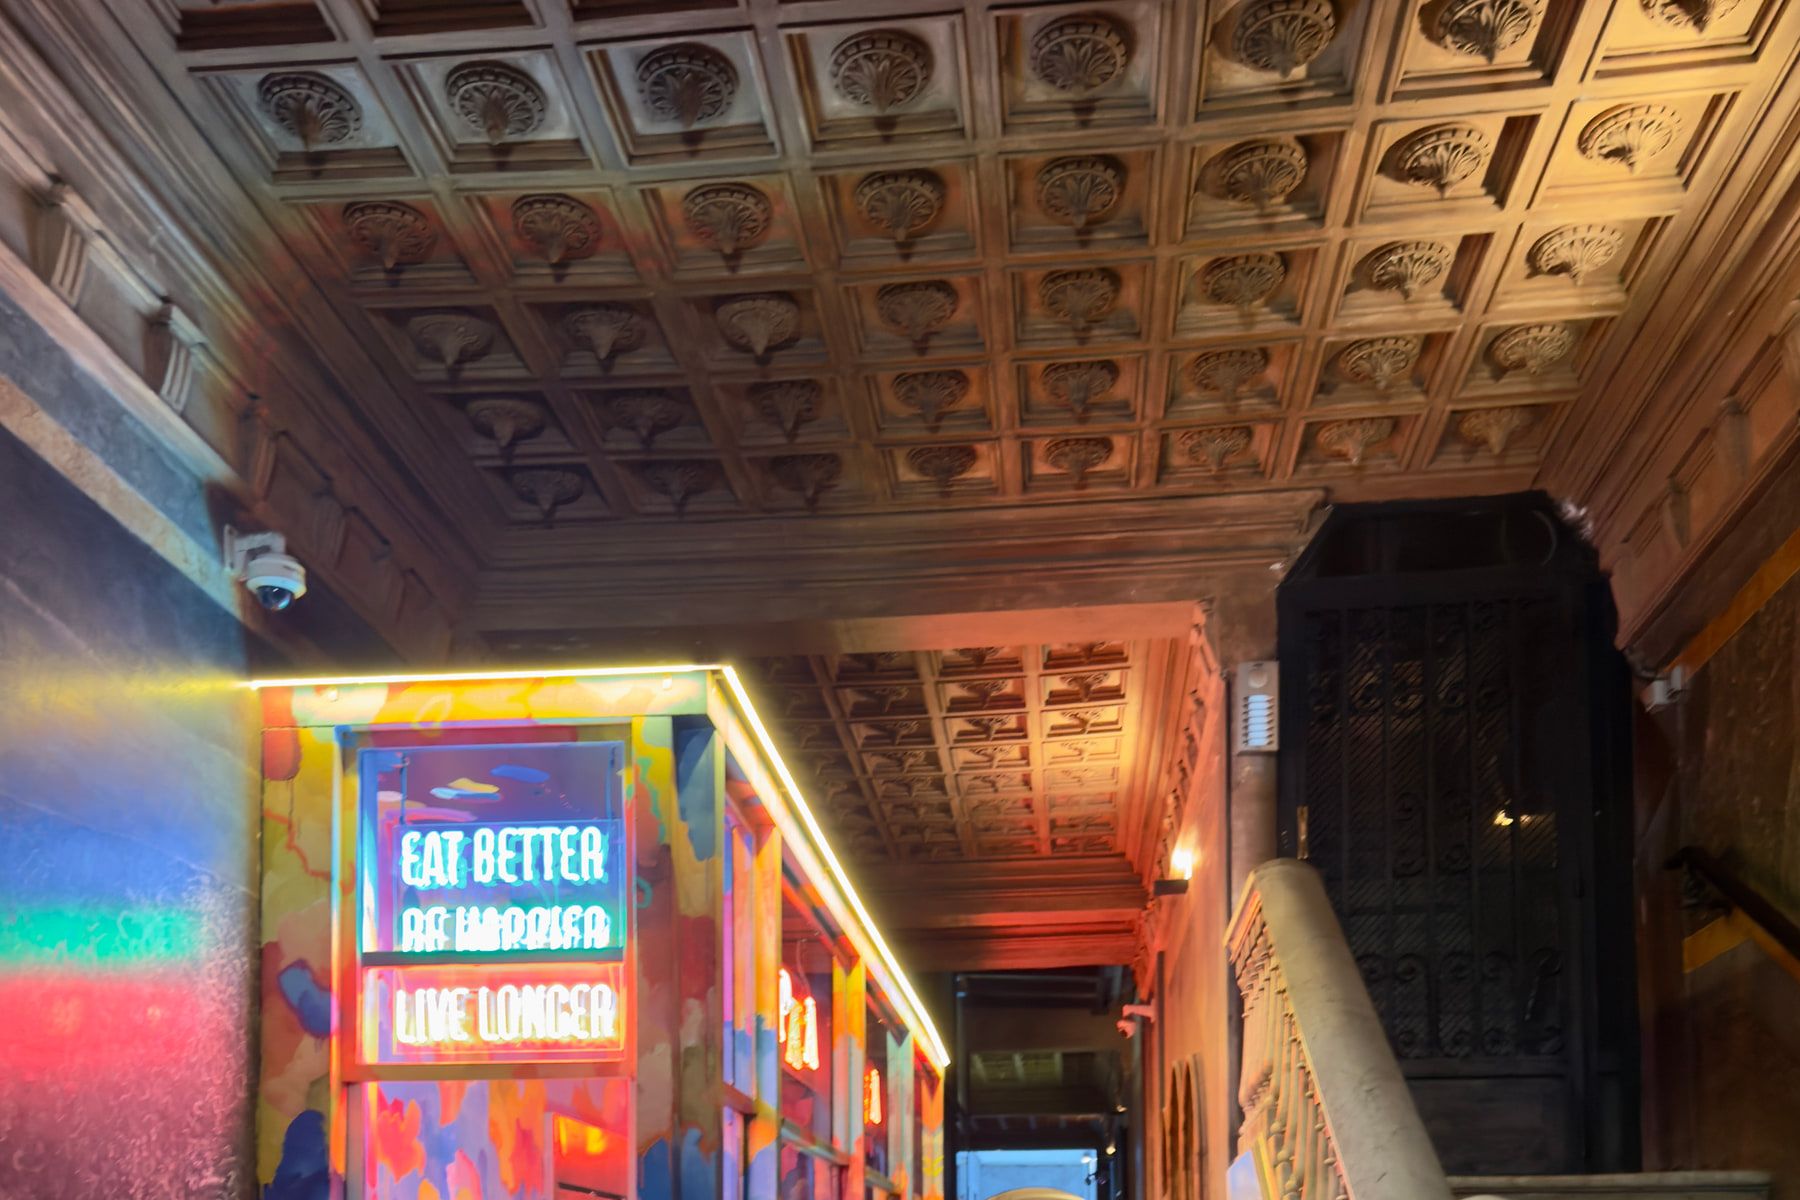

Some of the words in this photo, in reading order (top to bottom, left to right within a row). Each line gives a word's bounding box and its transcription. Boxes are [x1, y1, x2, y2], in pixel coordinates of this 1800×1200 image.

[401, 830, 465, 886] EAT
[473, 826, 603, 883] BETTER
[396, 986, 470, 1043] LIVE
[477, 983, 616, 1042] LONGER
